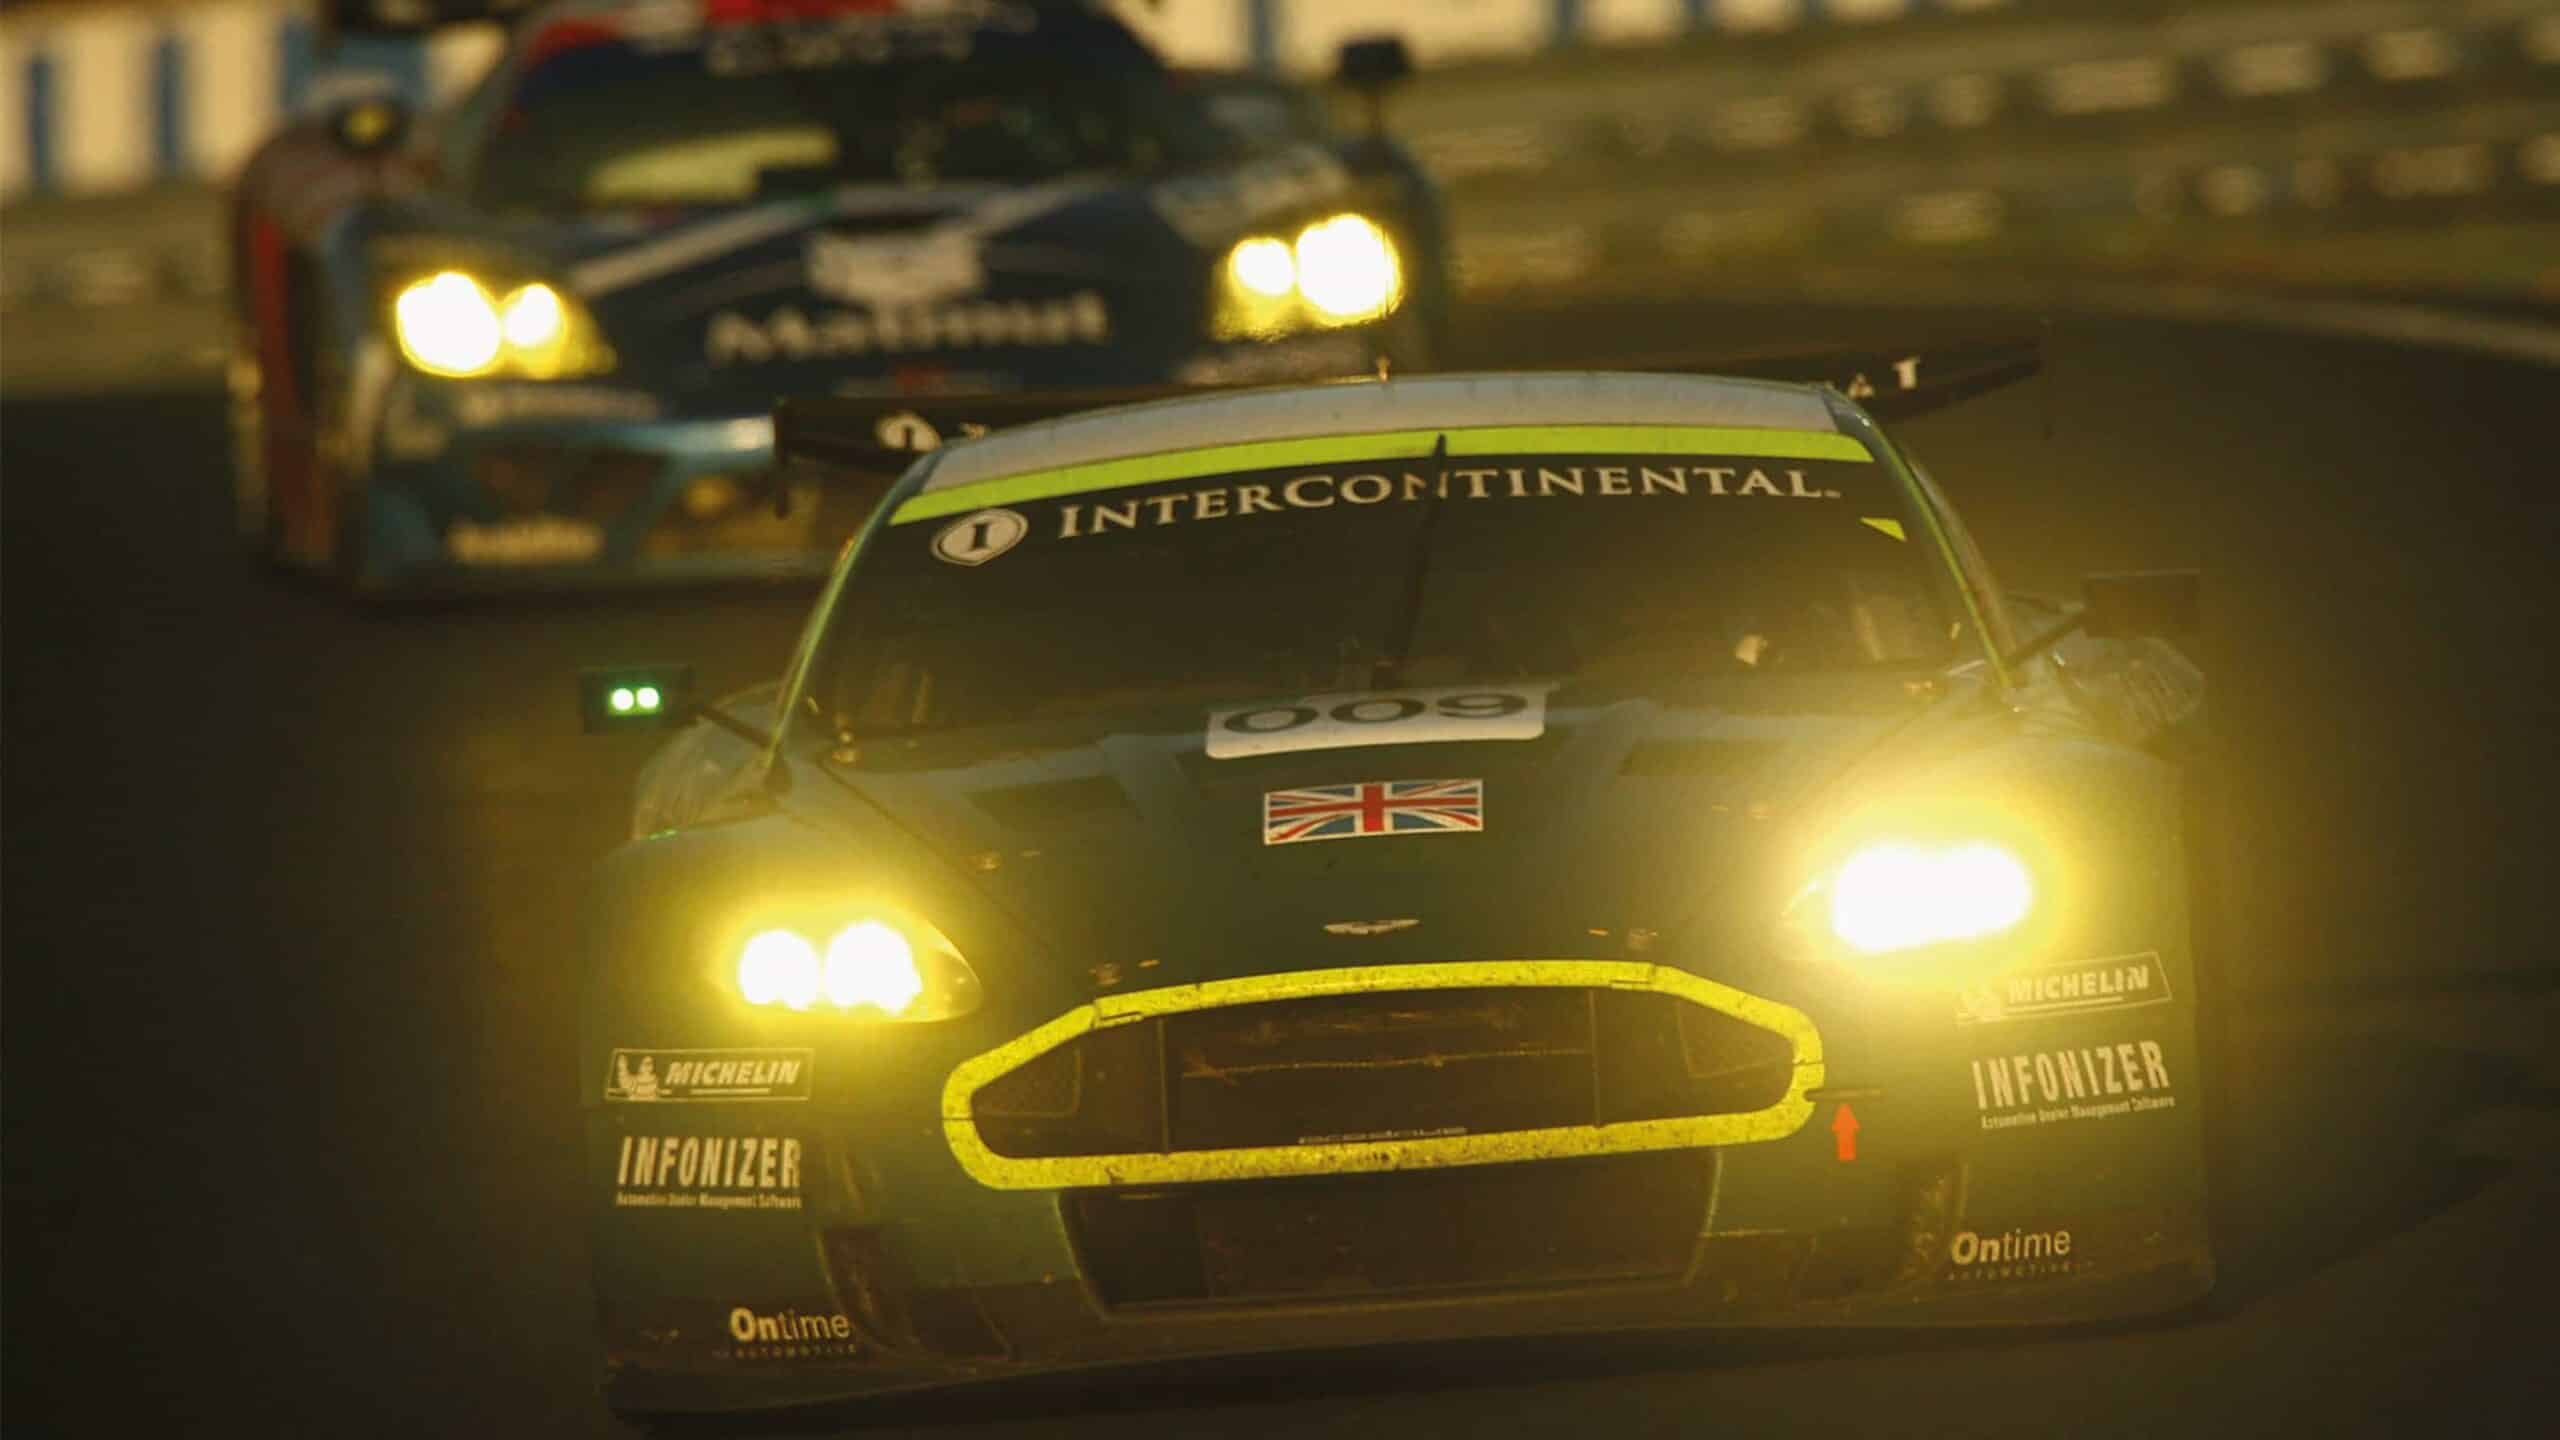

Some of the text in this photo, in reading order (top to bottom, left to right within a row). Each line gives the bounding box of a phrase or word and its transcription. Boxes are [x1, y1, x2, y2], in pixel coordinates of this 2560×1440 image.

[1223, 692, 1529, 734] 009
[2006, 964, 2150, 1003] MICHELIN
[664, 1061, 801, 1085] MICHELIN
[1972, 1040, 2169, 1110] INFONIZER
[617, 1136, 801, 1188] INFONIZER
[1951, 1227, 2071, 1264] Ontime
[730, 1306, 851, 1341] Ontime
